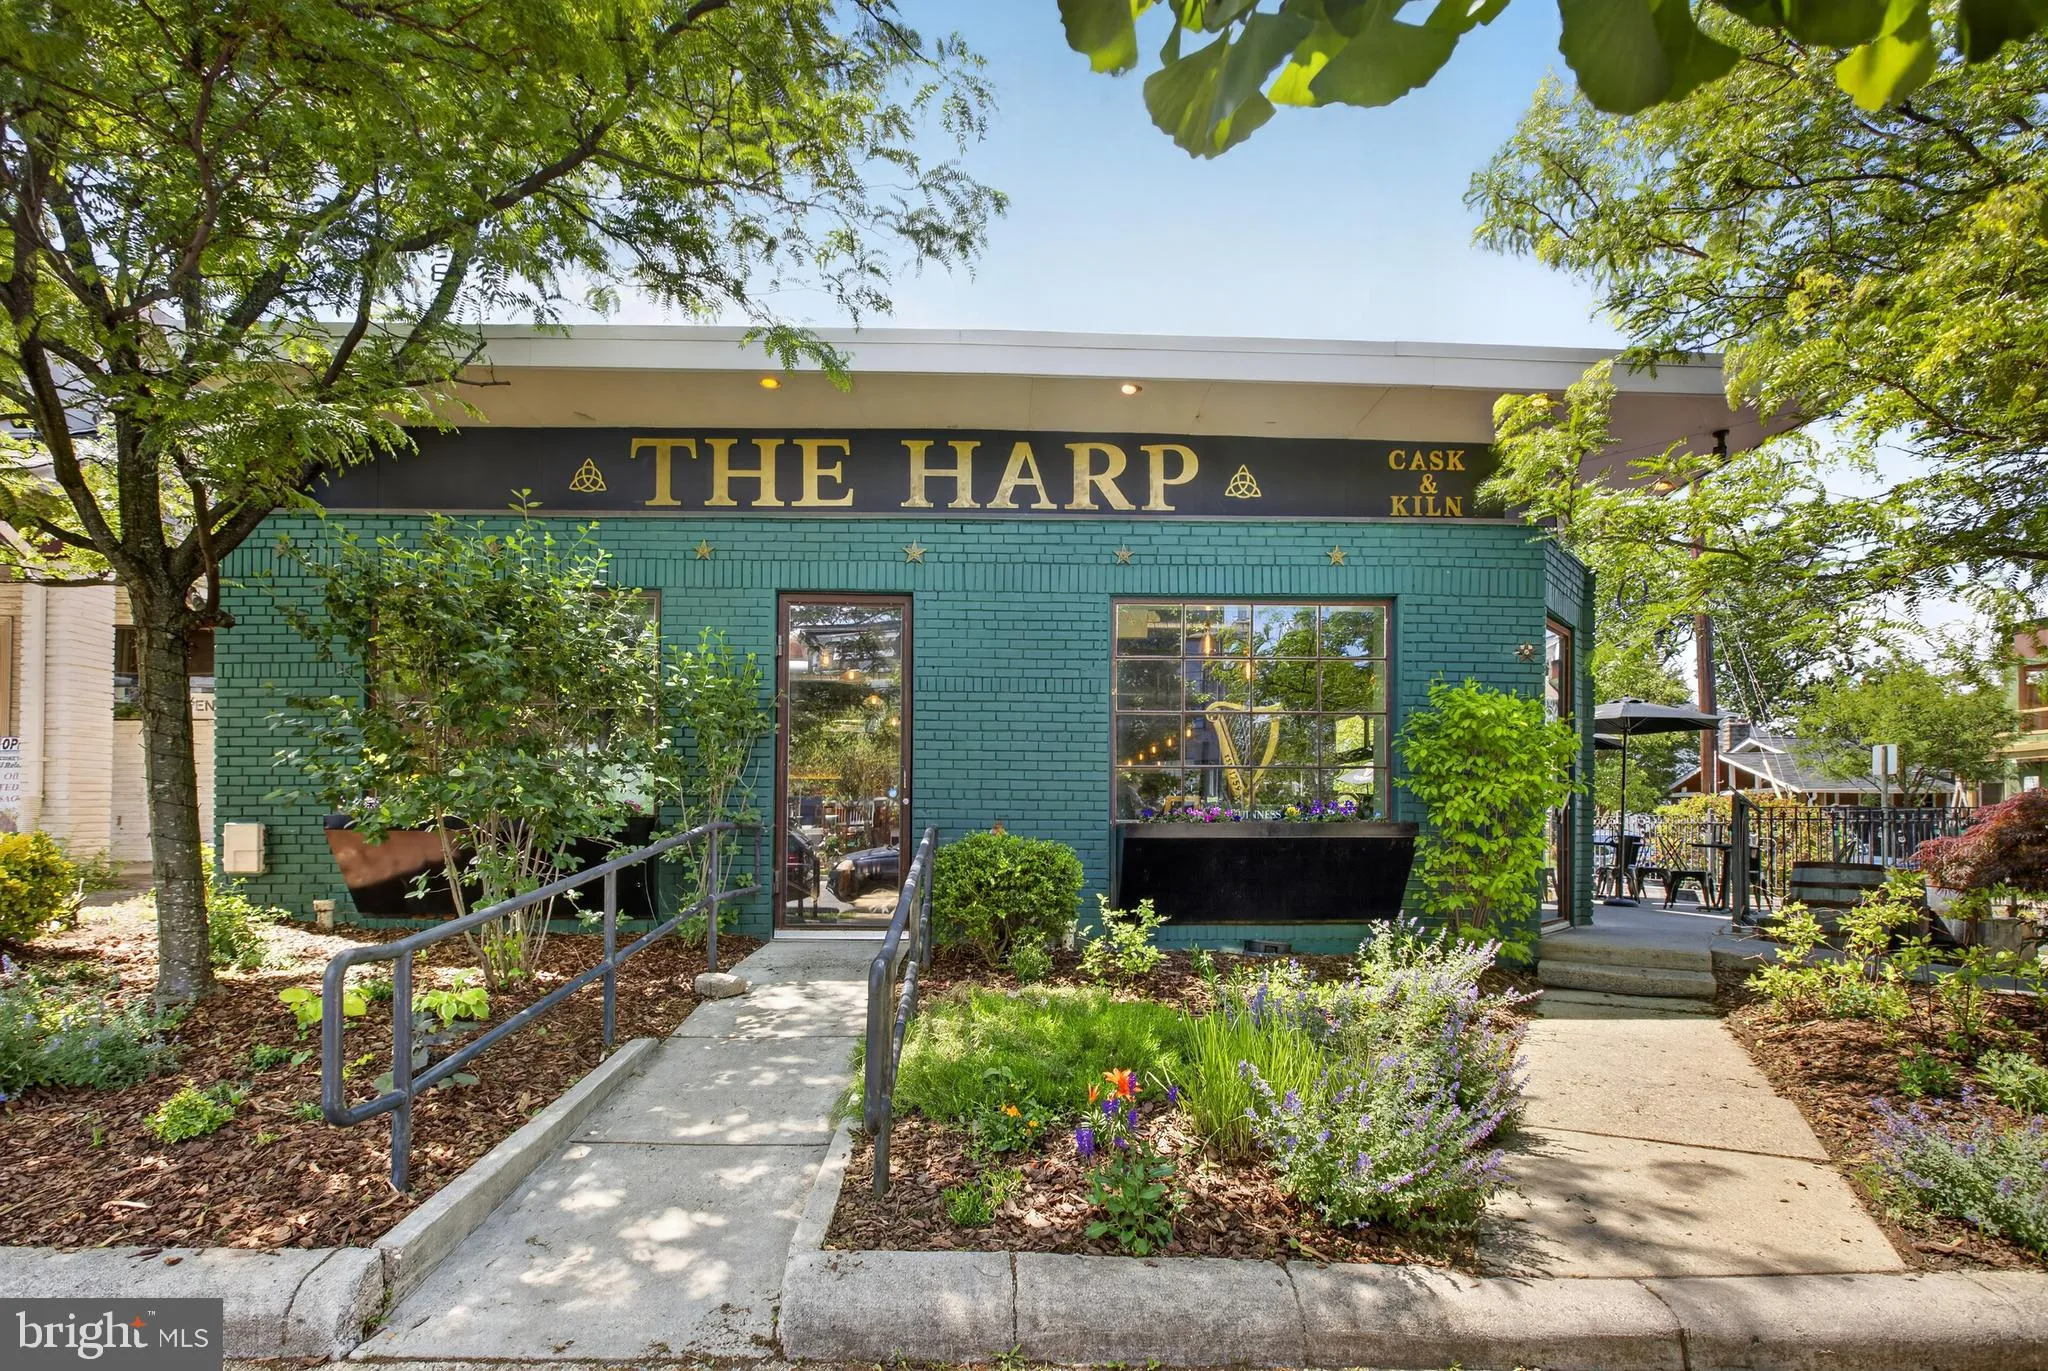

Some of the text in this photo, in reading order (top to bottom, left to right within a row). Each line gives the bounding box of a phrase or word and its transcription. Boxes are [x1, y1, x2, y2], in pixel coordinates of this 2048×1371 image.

[1388, 450, 1466, 471] CASK
[630, 438, 1199, 511] THE HARP
[1420, 474, 1438, 494] &
[1389, 496, 1463, 517] KILN
